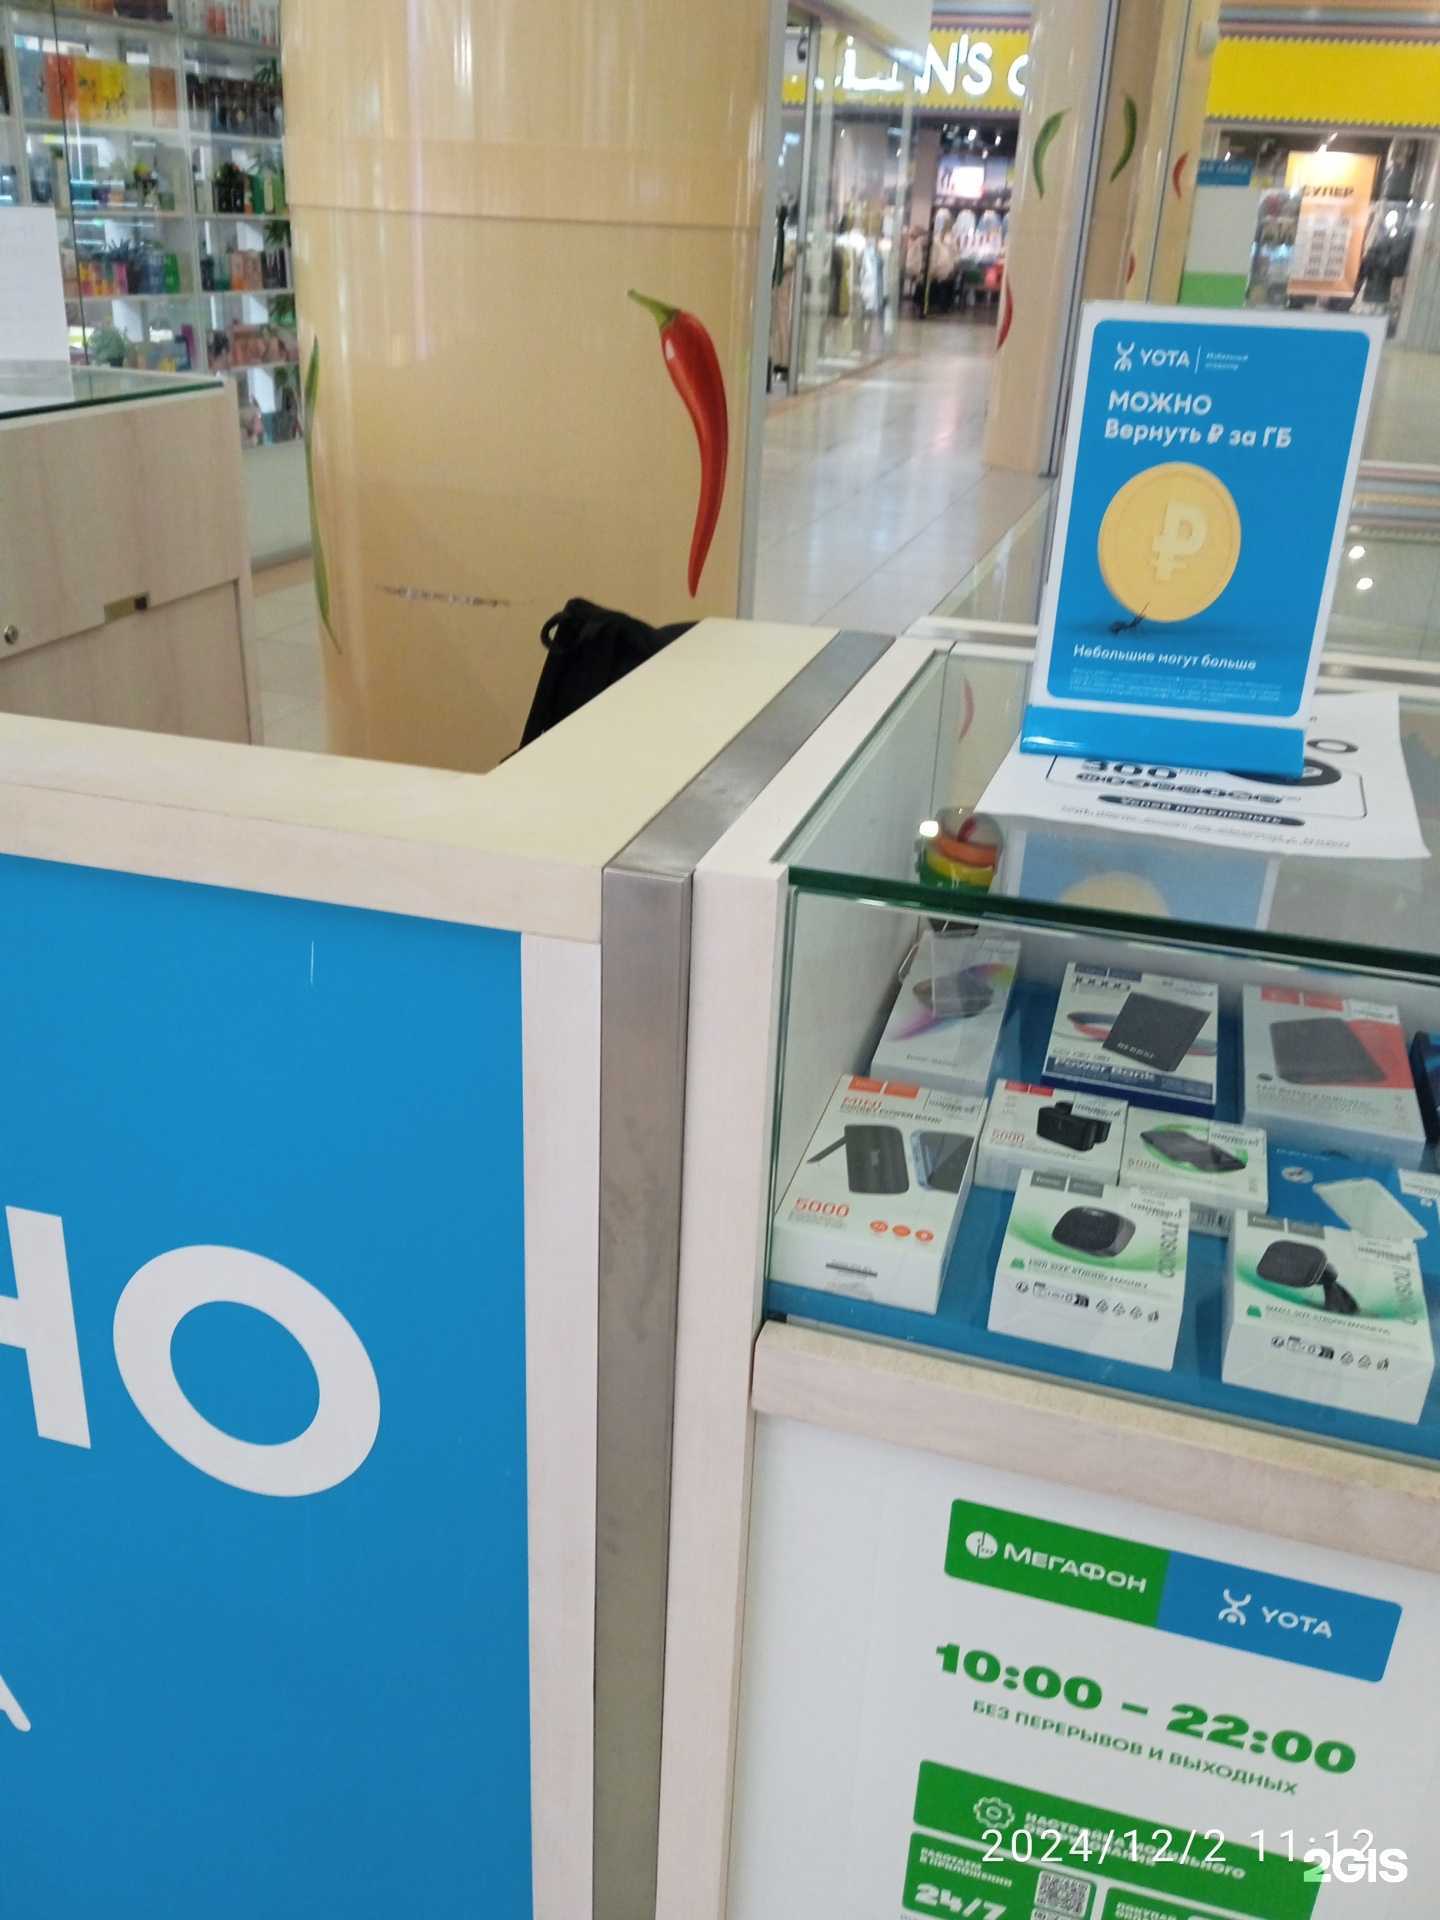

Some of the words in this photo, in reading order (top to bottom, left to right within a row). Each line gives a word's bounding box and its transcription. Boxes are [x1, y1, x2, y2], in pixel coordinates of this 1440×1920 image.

[1140, 348, 1190, 368] YOTA
[1108, 389, 1212, 416] МОЖНО
[1104, 418, 1202, 447] Вернуть
[1229, 429, 1256, 446] за
[1262, 425, 1292, 448] ГБ
[1073, 644, 1154, 663] Небольшие
[1158, 653, 1199, 668] могут
[1201, 654, 1257, 671] больше
[796, 1197, 849, 1217] 5000
[1004, 1542, 1147, 1593] МЕГАФОН
[1262, 1605, 1333, 1639] YOTA
[935, 1643, 1103, 1710] 10:00
[1166, 1703, 1357, 1774] 22:00
[973, 1700, 1009, 1720] БЕЗ
[1015, 1711, 1143, 1756] ПЕРЕРЫВОВ
[1148, 1746, 1165, 1762] И
[1169, 1752, 1298, 1795] ВЫХОДНЫХ
[914, 1883, 1006, 1920] 24/7
